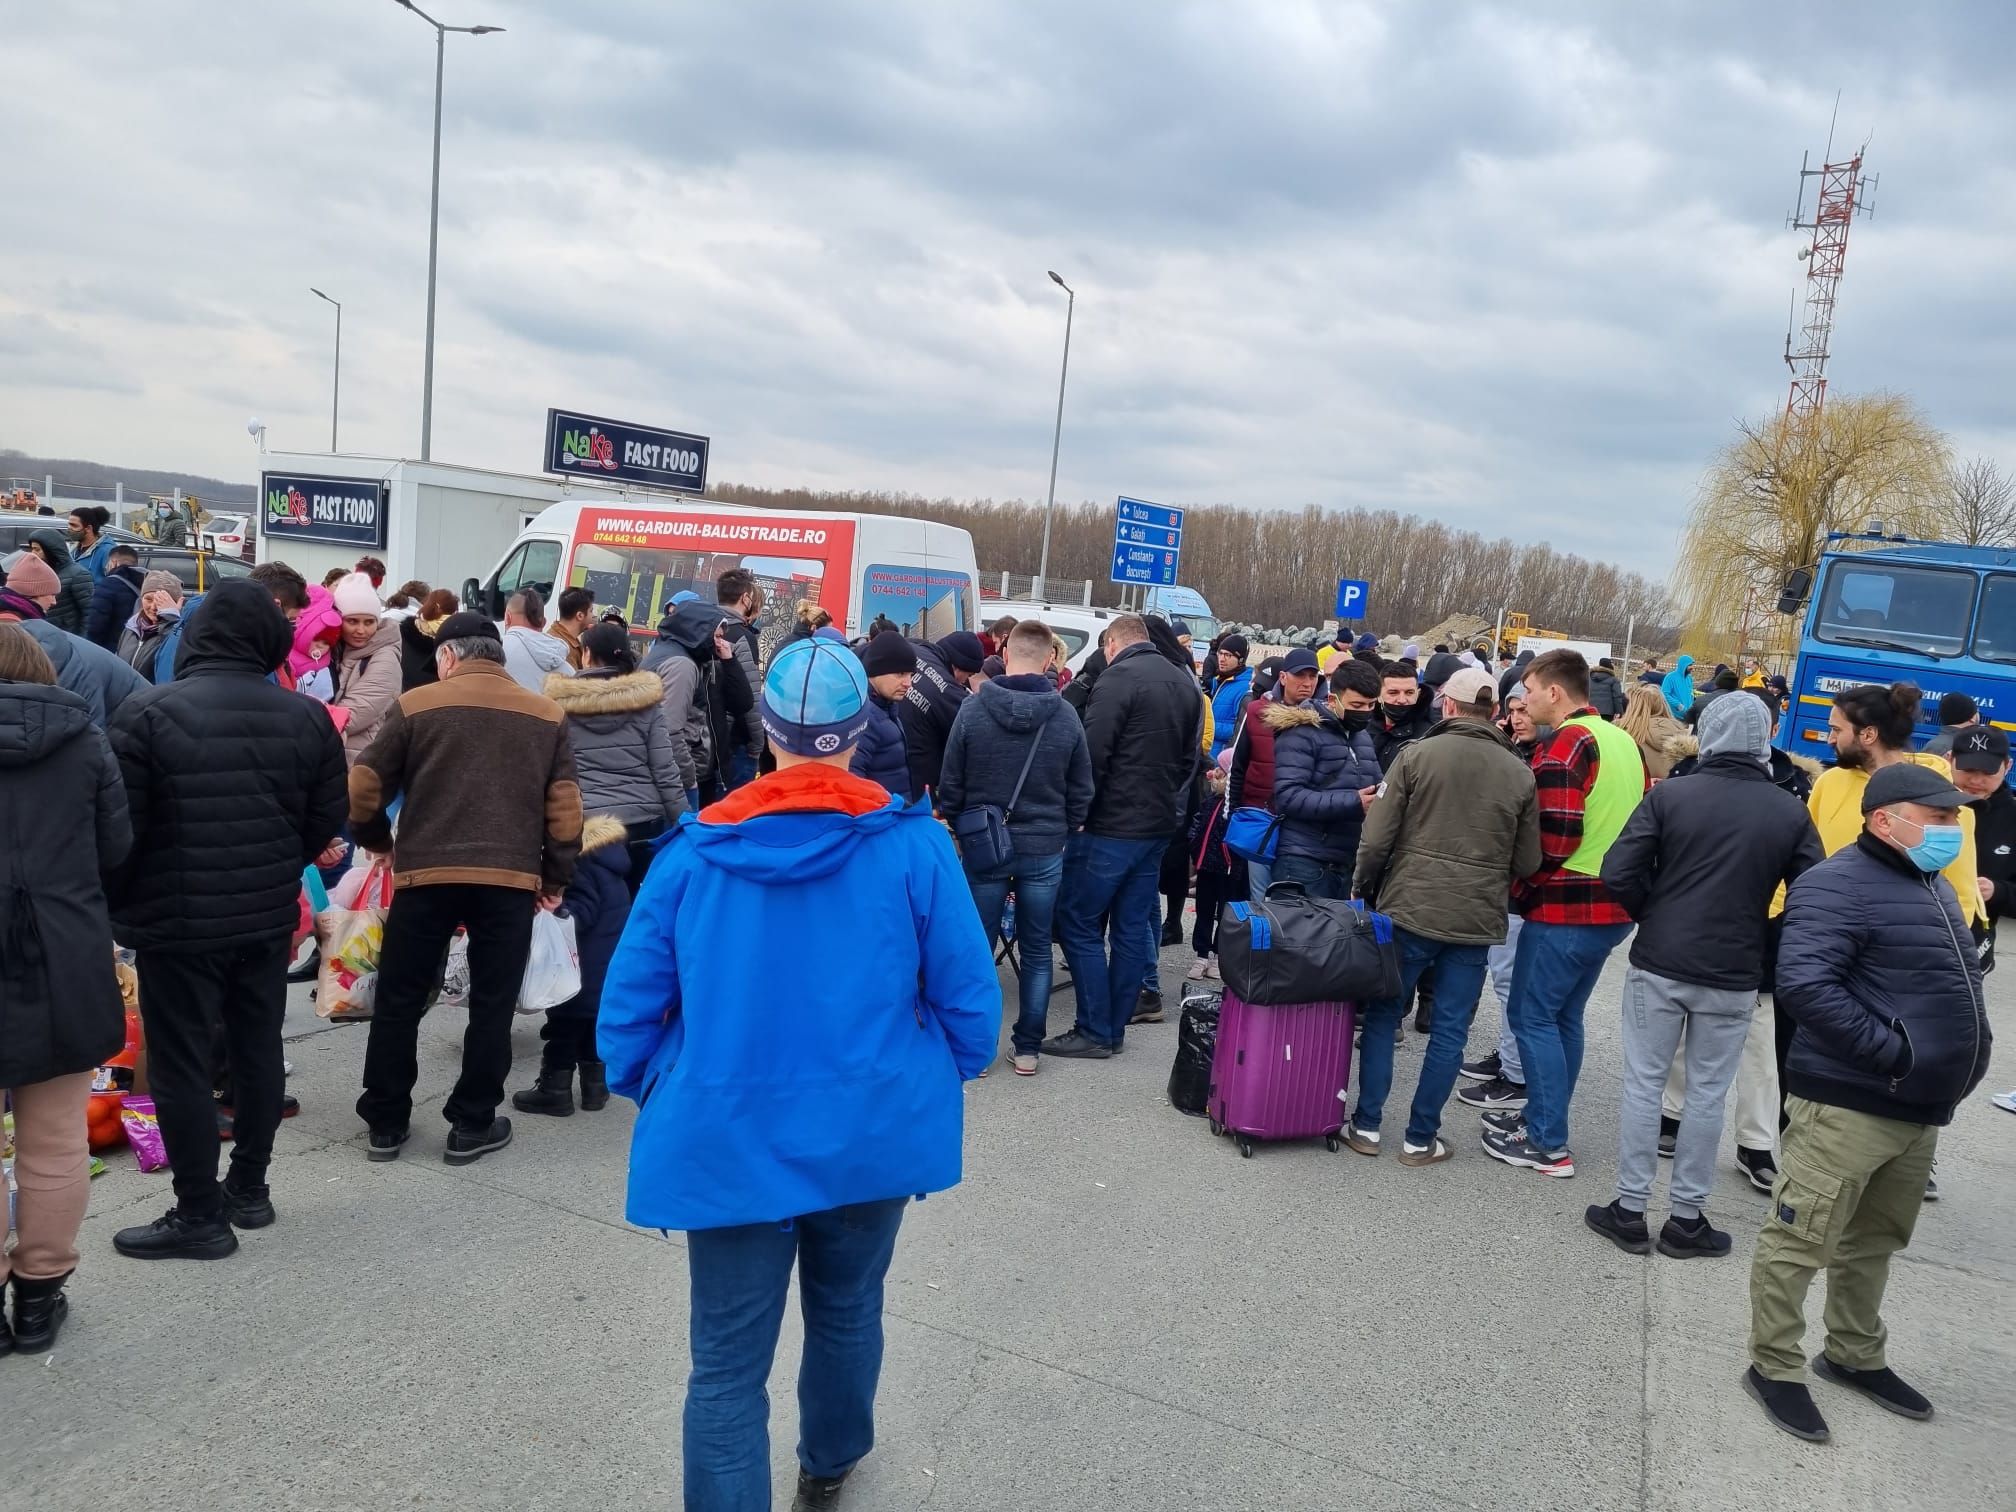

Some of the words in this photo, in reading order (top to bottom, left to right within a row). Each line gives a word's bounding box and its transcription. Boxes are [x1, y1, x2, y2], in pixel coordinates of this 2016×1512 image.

[624, 440, 661, 468] FAST
[662, 447, 699, 473] FOOD
[313, 494, 342, 521] FAST
[343, 497, 375, 524] FOOD
[1133, 506, 1149, 520] Tulcea
[593, 532, 613, 543] 0744
[614, 534, 630, 544] 642
[631, 535, 647, 545] 148
[597, 518, 827, 545] WWW.GARDURI-BALUSTRADE.RO
[872, 584, 893, 594] 0744
[896, 586, 911, 596] 642
[1344, 585, 1361, 607] P
[924, 666, 948, 693] GENERAL
[1969, 733, 1989, 751] NY
